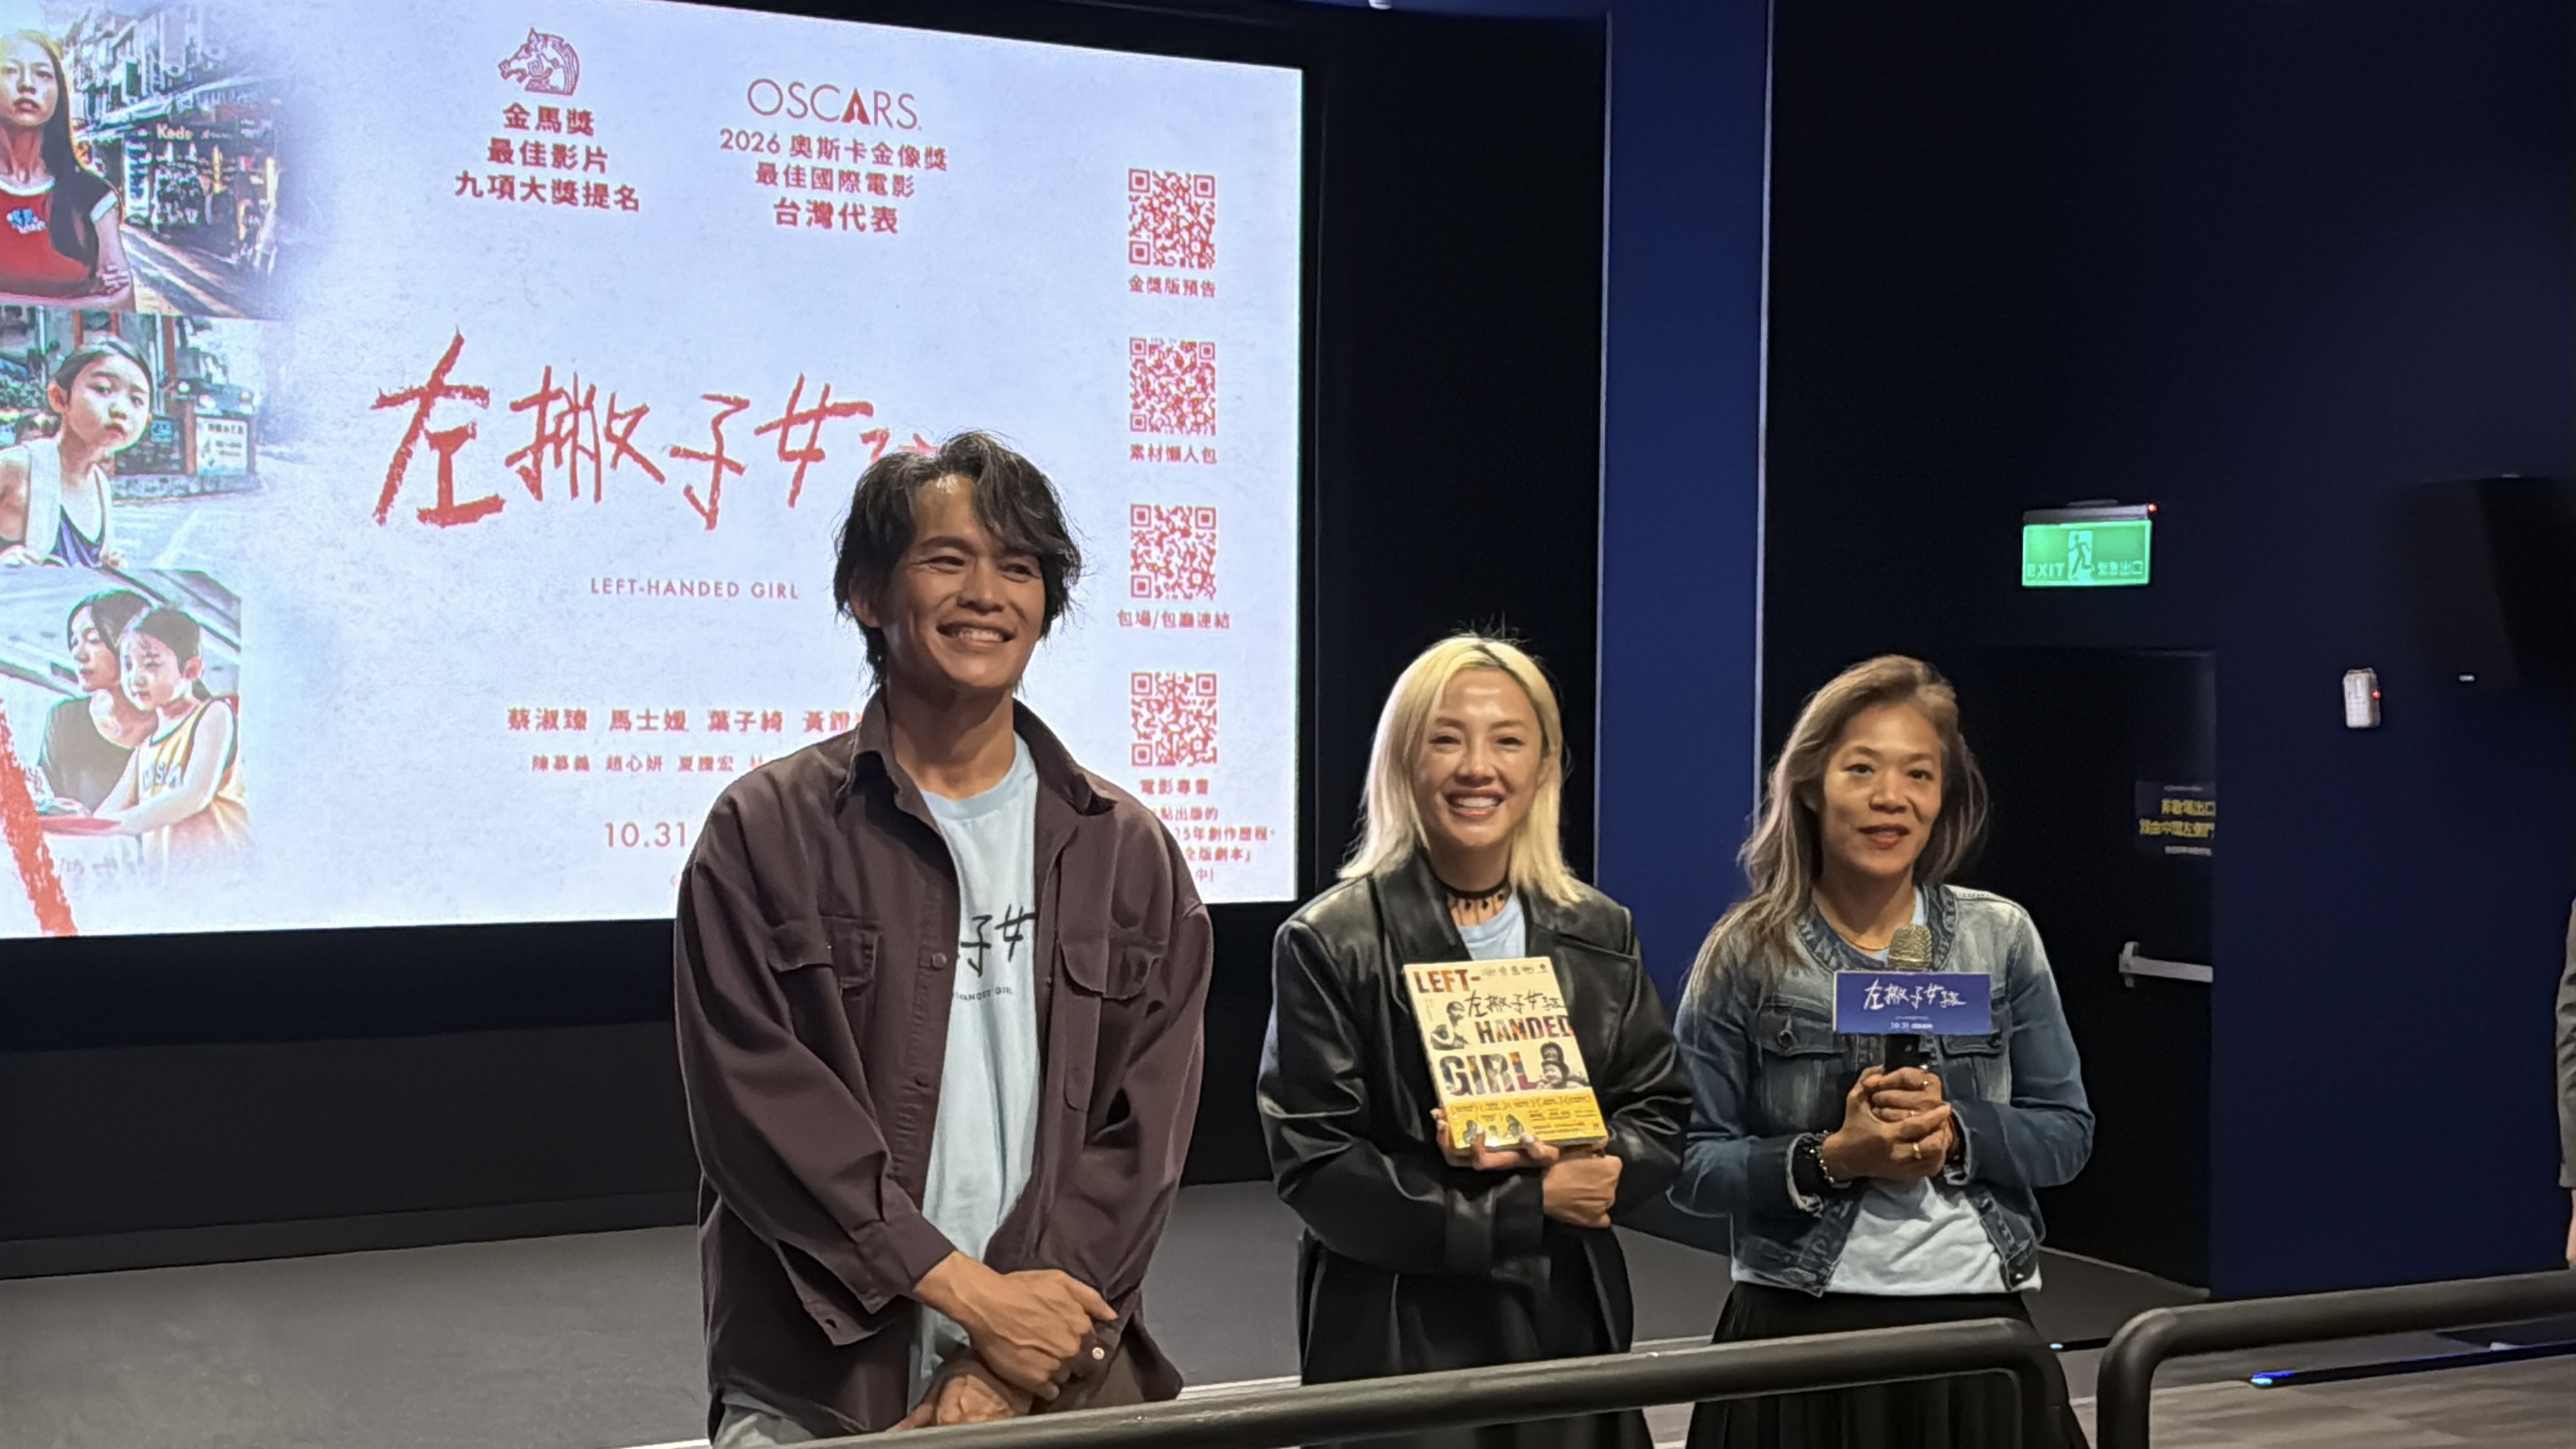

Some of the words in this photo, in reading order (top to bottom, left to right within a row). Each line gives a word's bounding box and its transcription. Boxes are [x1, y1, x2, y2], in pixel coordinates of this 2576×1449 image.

[502, 102, 594, 137] 金馬獎
[746, 78, 918, 130] OSCARS
[487, 137, 609, 174] 最佳影片
[719, 128, 781, 155] 2026
[789, 134, 947, 173] 奧斯卡金像獎
[455, 171, 641, 212] 九項大獎提名
[755, 161, 915, 198] 最佳國際電影
[772, 197, 898, 234] 台灣代表
[1129, 274, 1216, 298] 金獎版預告
[370, 325, 939, 531] 左撇子女
[1129, 443, 1217, 465] 素材懶人包
[2027, 562, 2065, 579] EXIT
[591, 577, 740, 598] LEFT-HANDED
[750, 581, 799, 600] GIRL
[803, 711, 862, 733] 黃鐙
[1140, 777, 1210, 796] 電影專書
[605, 822, 687, 848] 10.31
[1413, 969, 1481, 993] LEFT-
[1439, 1051, 1541, 1096] GIRL
